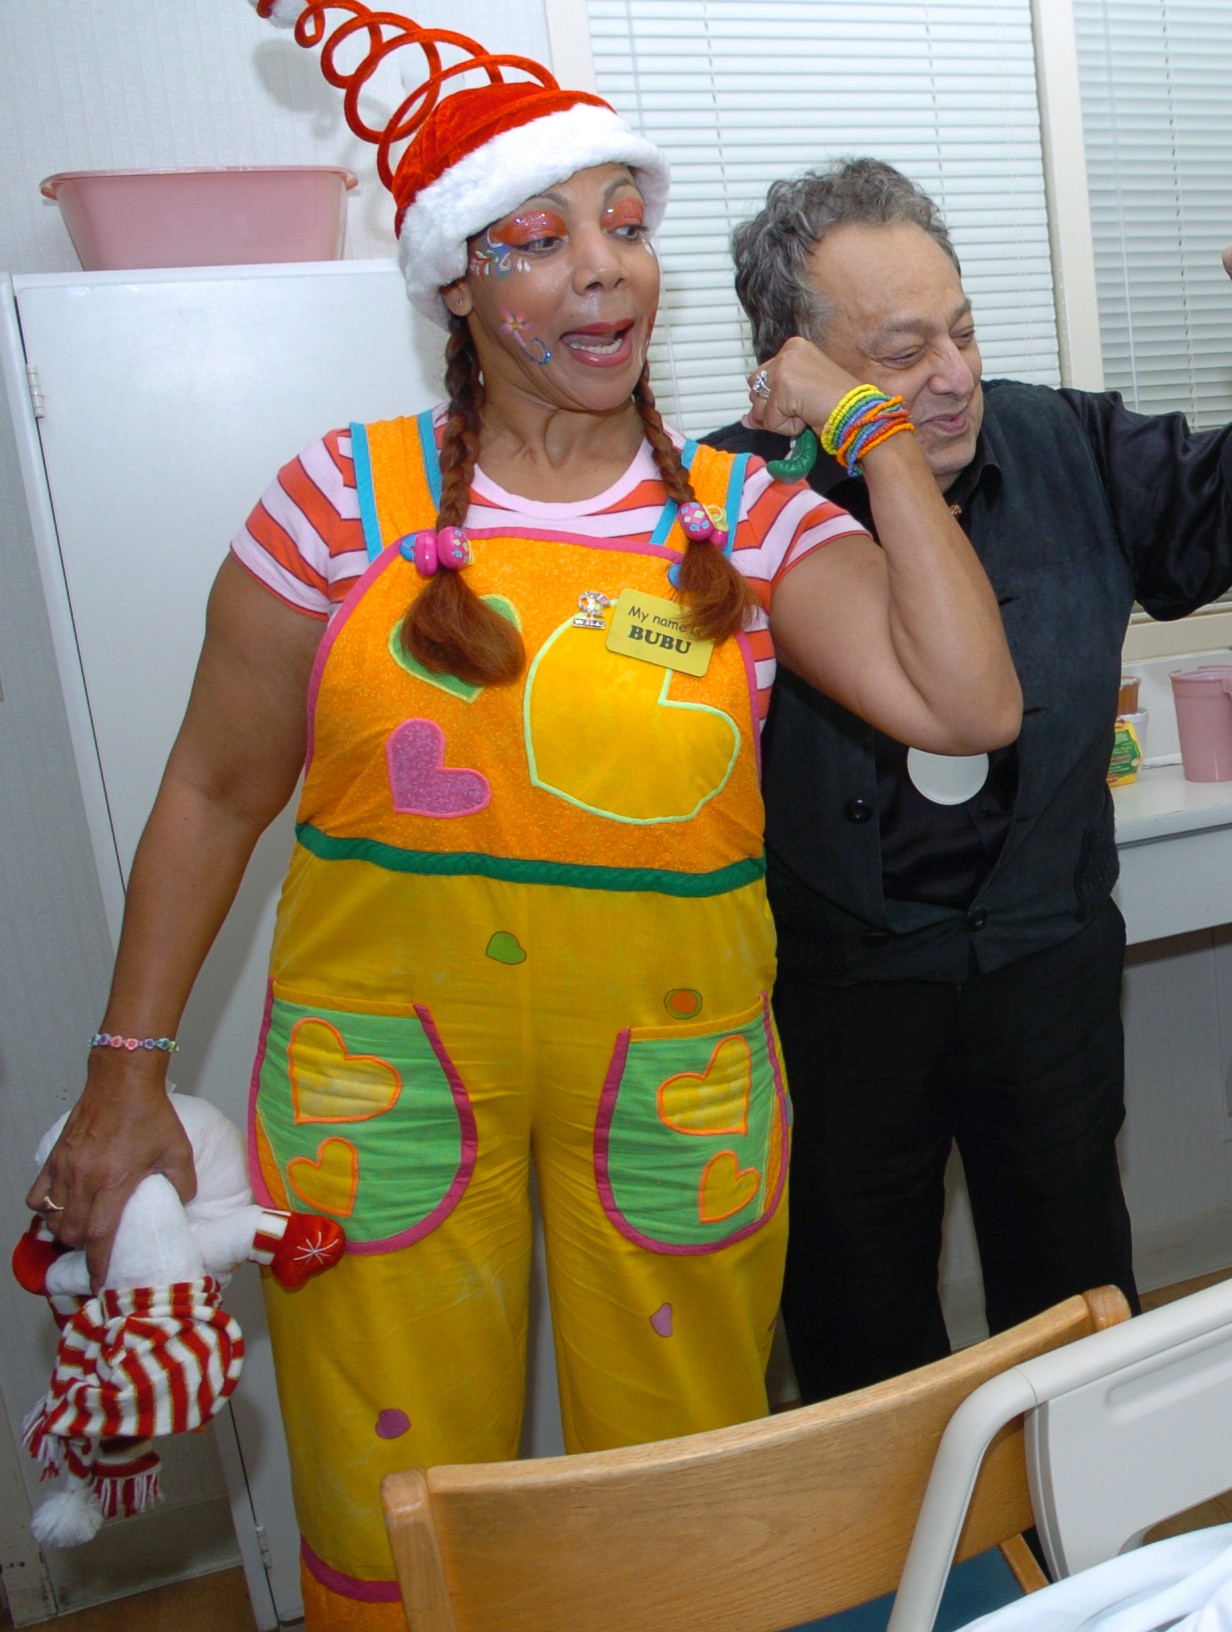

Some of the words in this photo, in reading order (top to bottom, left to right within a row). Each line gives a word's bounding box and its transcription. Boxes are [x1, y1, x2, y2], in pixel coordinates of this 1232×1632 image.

[628, 605, 649, 623] My
[653, 614, 686, 632] name
[628, 624, 692, 654] BUBU
